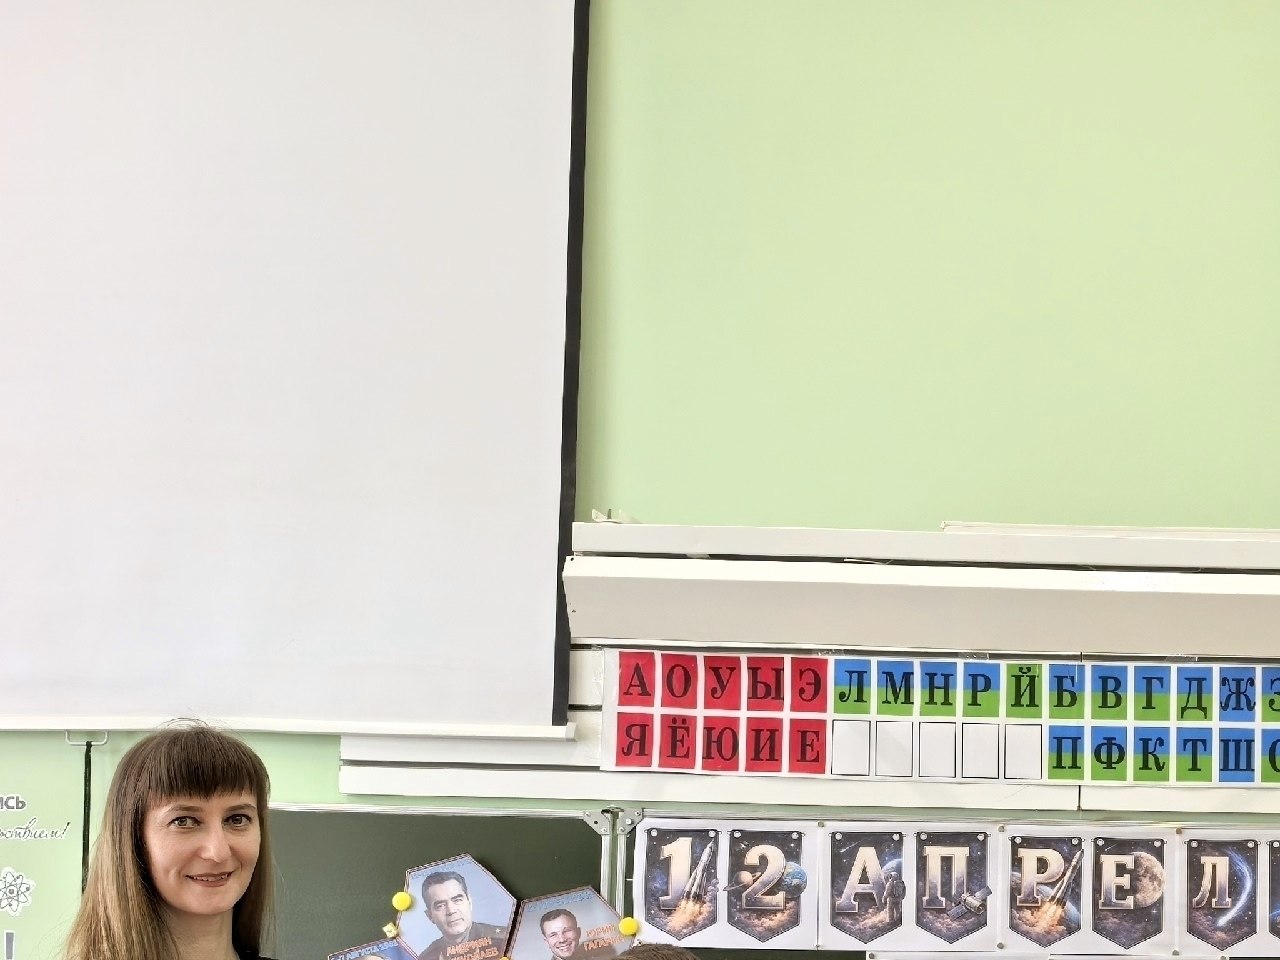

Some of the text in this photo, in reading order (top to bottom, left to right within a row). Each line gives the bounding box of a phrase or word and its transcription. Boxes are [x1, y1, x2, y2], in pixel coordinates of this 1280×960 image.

[623, 663, 651, 696] А
[666, 663, 693, 697] О
[710, 666, 736, 698] У
[749, 667, 785, 700] Ы
[799, 668, 822, 701] Э
[839, 670, 869, 703] Л
[882, 671, 914, 705] М
[927, 672, 954, 705] Н
[968, 673, 993, 706] Р
[1011, 667, 1039, 708] Й
[1053, 675, 1079, 708] Б
[1098, 676, 1123, 709] В
[1141, 677, 1164, 710] Г
[1181, 678, 1208, 719] Д
[1220, 677, 1256, 712] Ж
[622, 724, 650, 757] Я
[666, 718, 690, 759] Ё
[702, 727, 738, 760] Ю
[751, 729, 779, 761] И
[796, 730, 820, 763] Е
[1053, 737, 1082, 769] П
[1093, 737, 1126, 770] Ф
[1139, 738, 1165, 771] К
[1184, 739, 1208, 771] Т
[1220, 739, 1255, 771] Ш
[659, 837, 788, 913] 12
